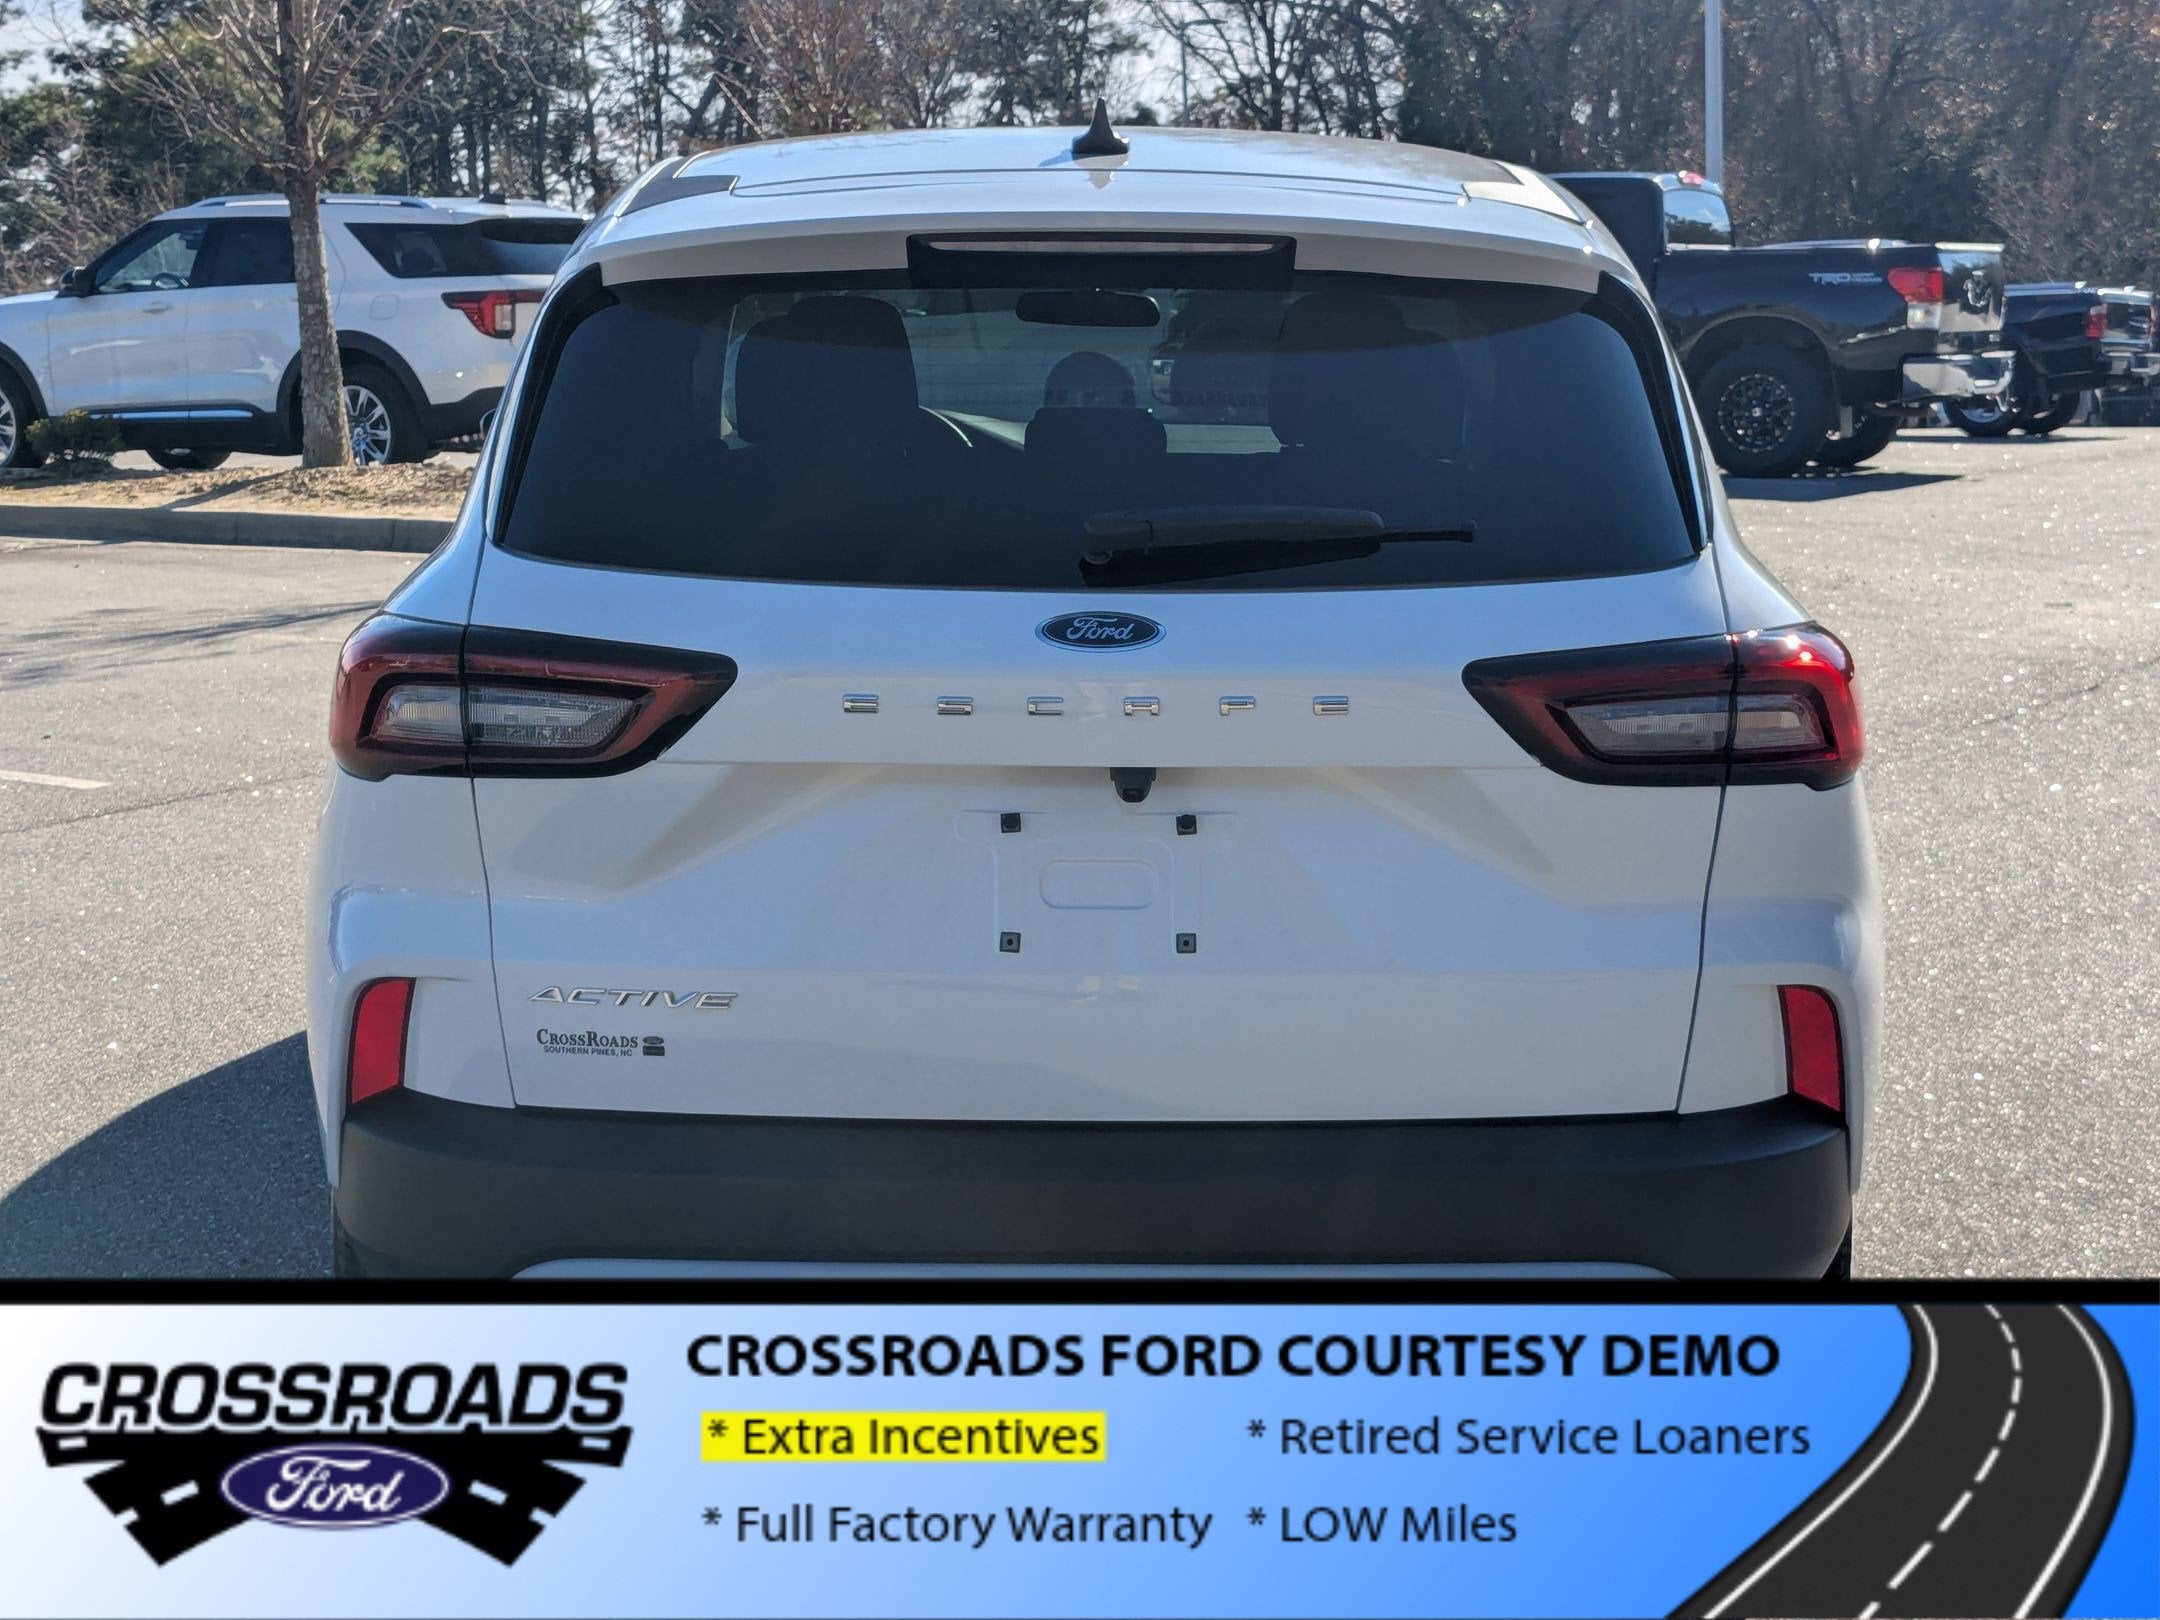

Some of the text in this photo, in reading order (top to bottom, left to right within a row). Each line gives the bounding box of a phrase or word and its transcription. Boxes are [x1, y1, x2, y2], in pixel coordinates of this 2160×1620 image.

[1065, 617, 1135, 641] Ford
[842, 693, 1350, 716] ESCAPE
[528, 985, 738, 1010] ACTIVE
[543, 1045, 589, 1055] SOUTHERN
[590, 1048, 620, 1057] PINES,
[620, 1049, 633, 1057] NC
